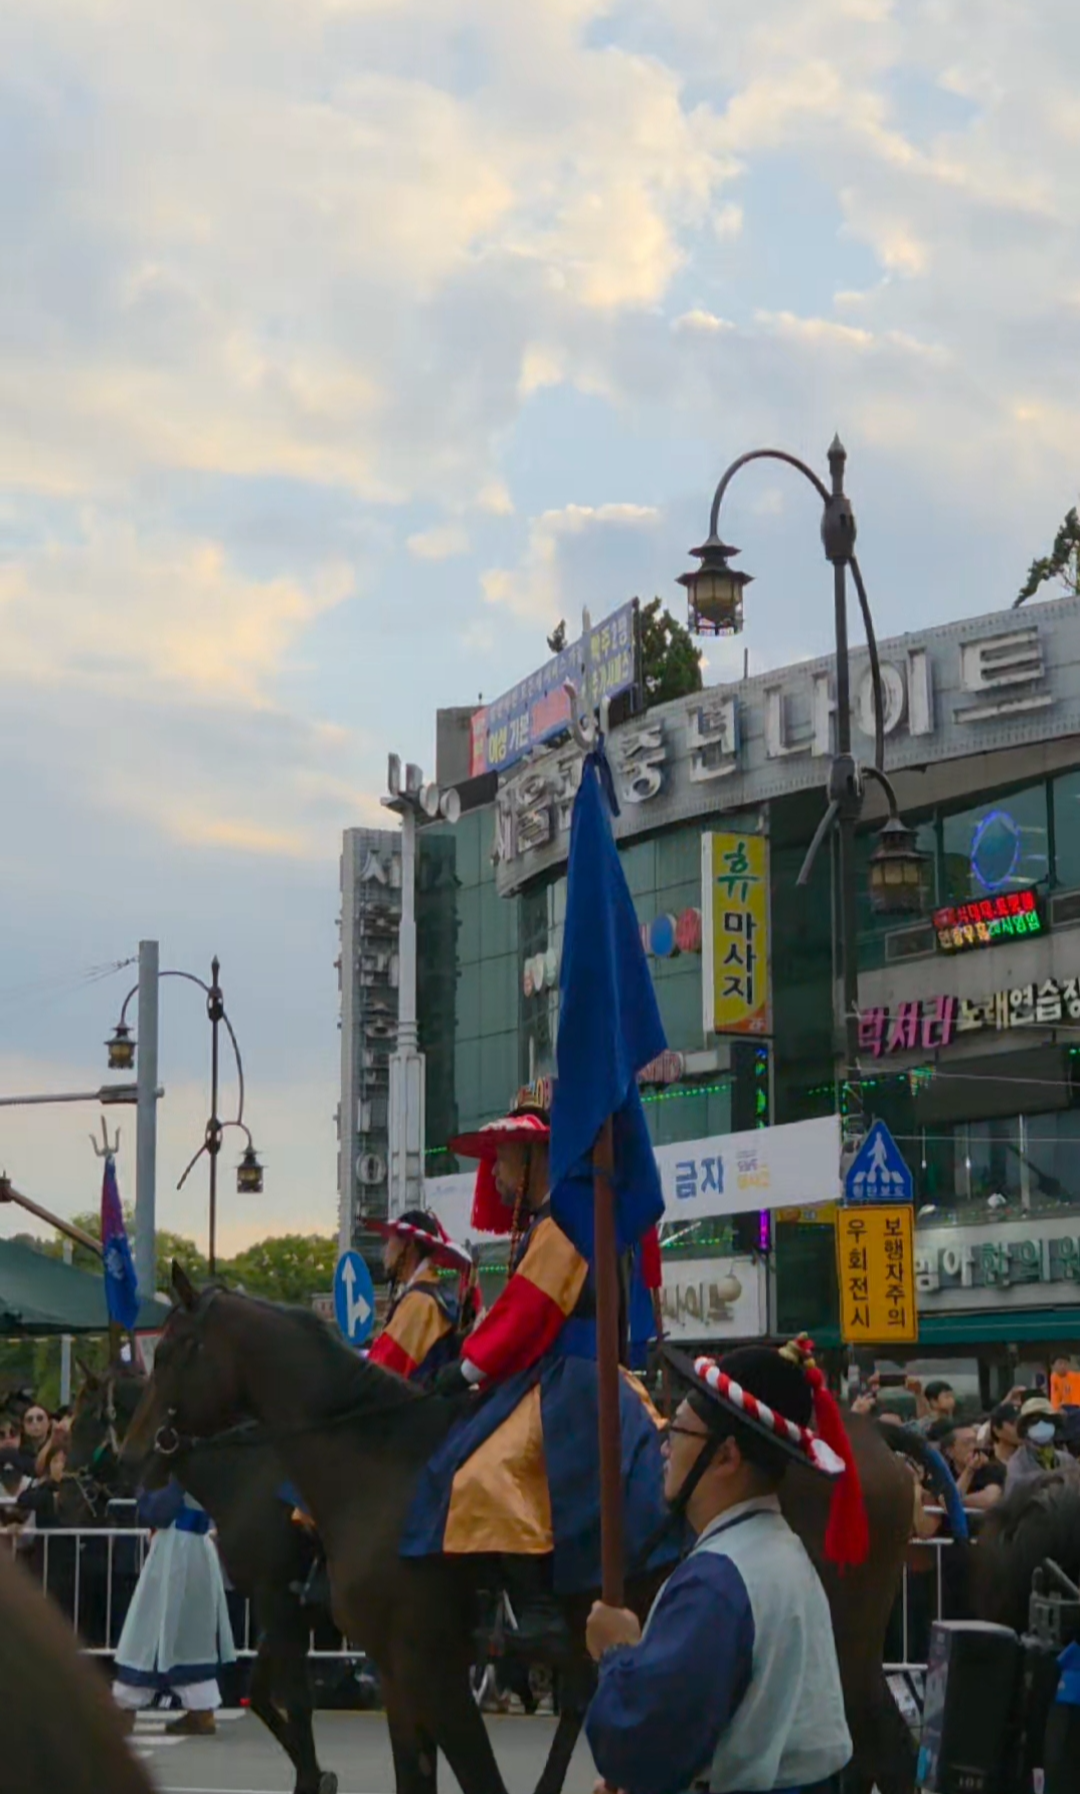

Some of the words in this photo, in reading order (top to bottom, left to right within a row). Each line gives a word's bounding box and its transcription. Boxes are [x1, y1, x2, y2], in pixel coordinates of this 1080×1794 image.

[721, 910, 758, 1006] 마사지
[675, 1154, 725, 1199] 금지
[852, 1185, 906, 1198] 횡단보도
[846, 1218, 870, 1330] 우회전시
[883, 1215, 906, 1330] 보행자주의
